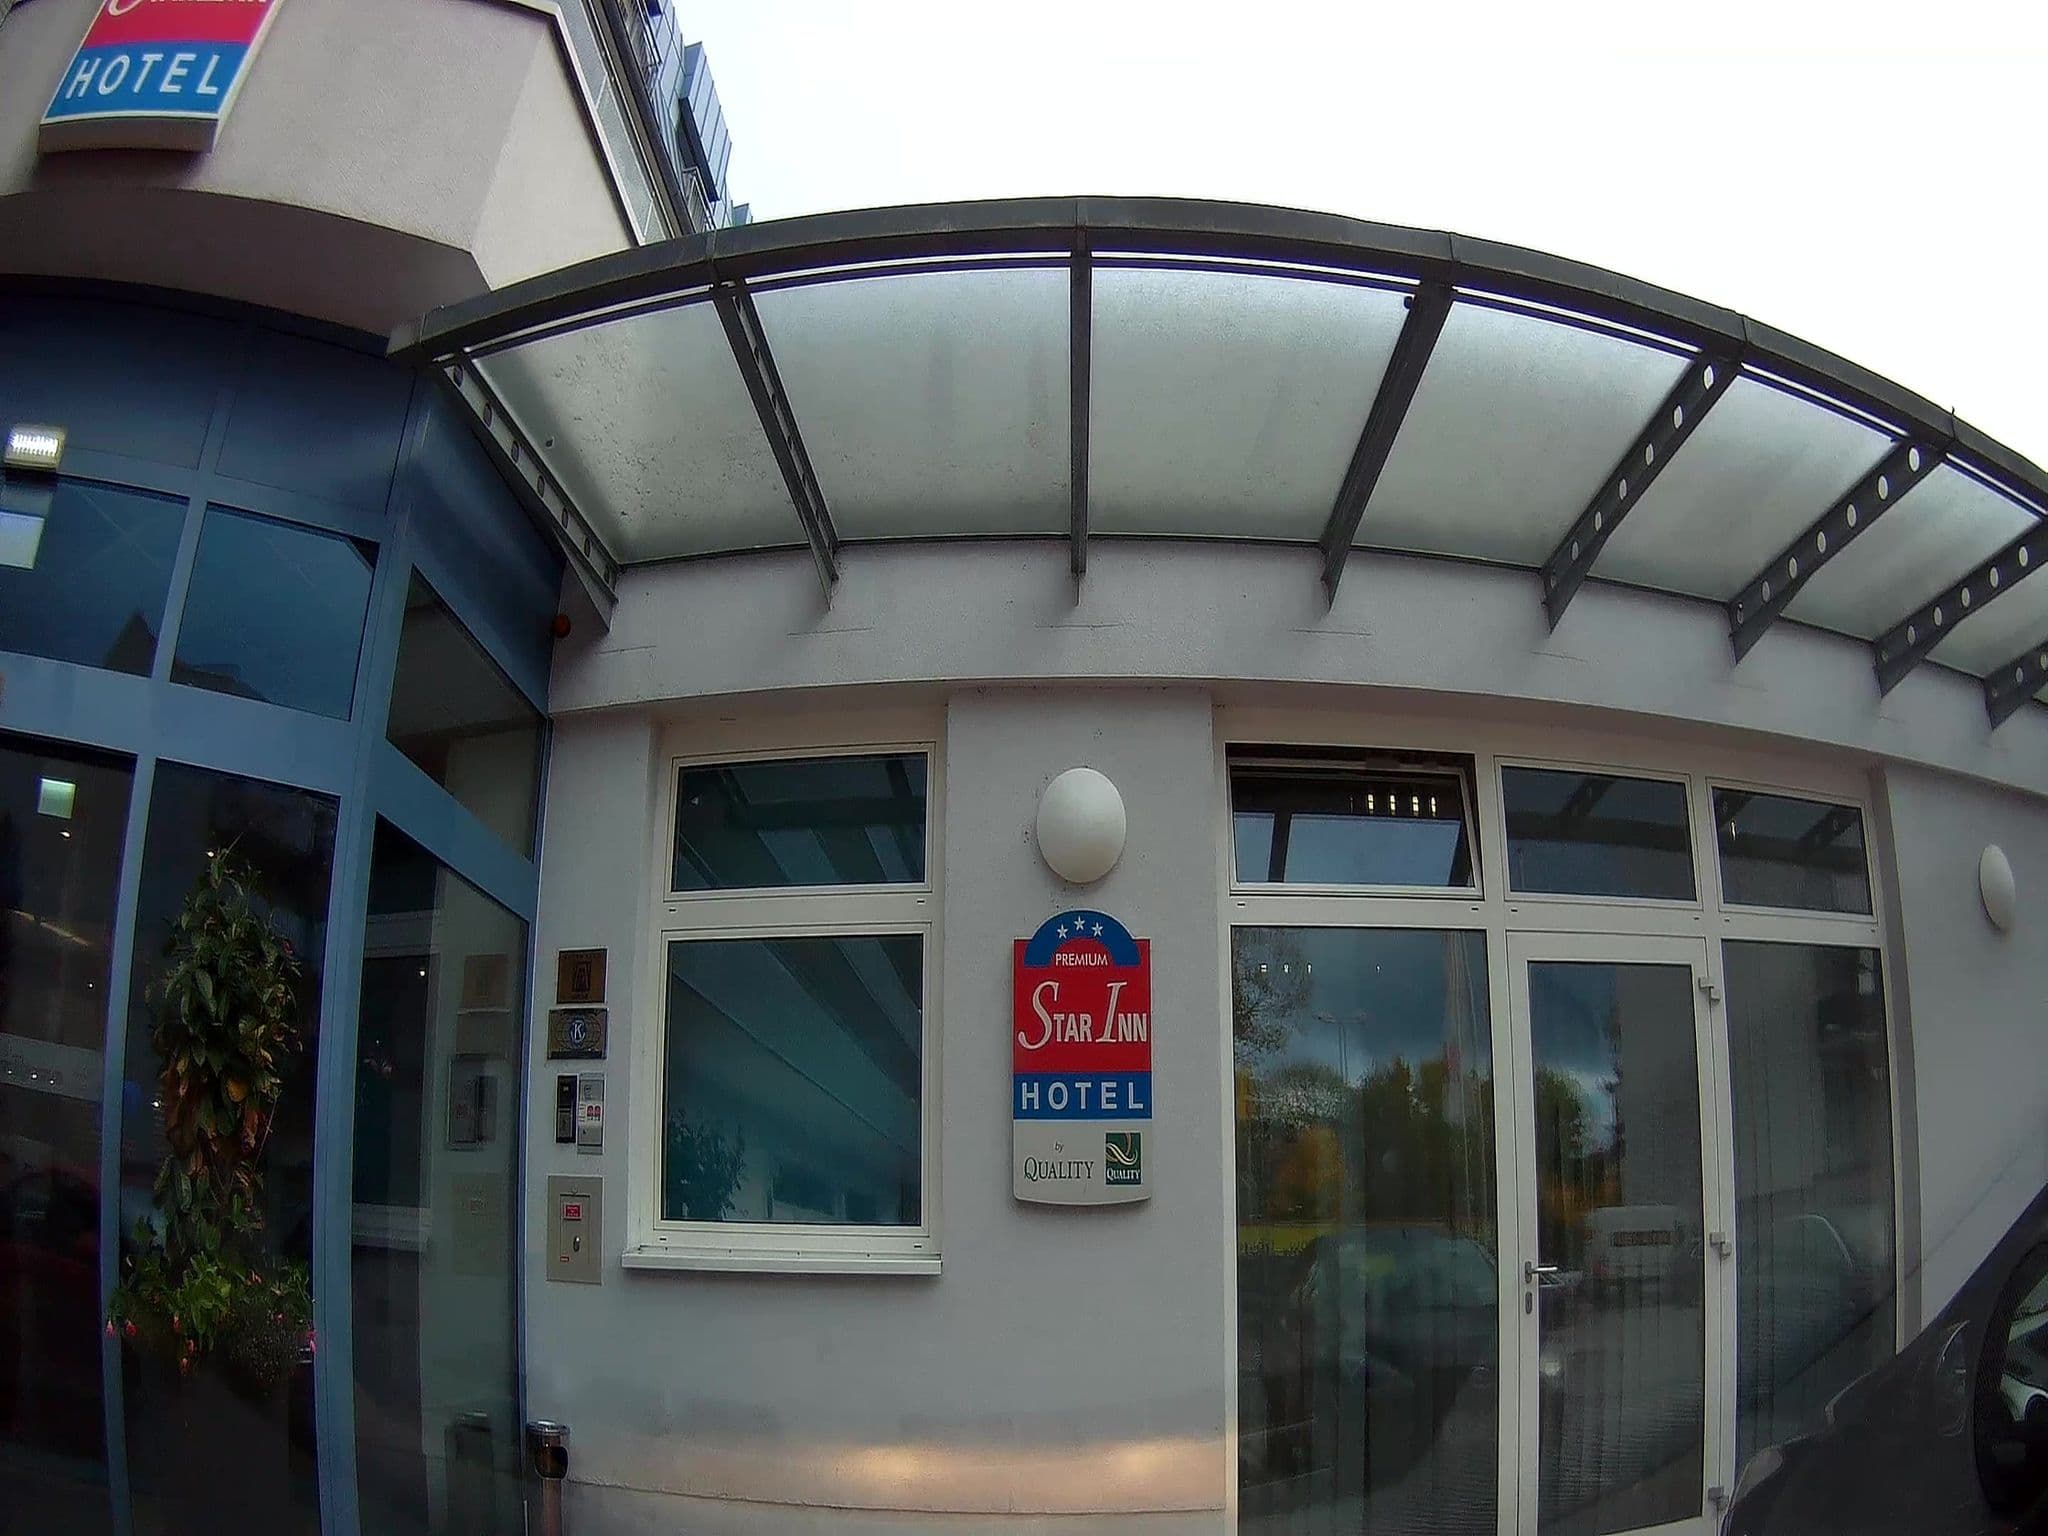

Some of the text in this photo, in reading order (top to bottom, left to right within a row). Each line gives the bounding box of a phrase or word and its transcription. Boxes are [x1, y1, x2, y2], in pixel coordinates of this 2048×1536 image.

[65, 53, 220, 100] HOTEL
[1055, 953, 1108, 967] PREMIUM
[1018, 981, 1148, 1050] STAR INN
[1021, 1081, 1144, 1110] HOTEL
[1055, 1141, 1063, 1152] by
[1023, 1156, 1094, 1181] QUALITY
[1106, 1168, 1141, 1182] QUALITY
